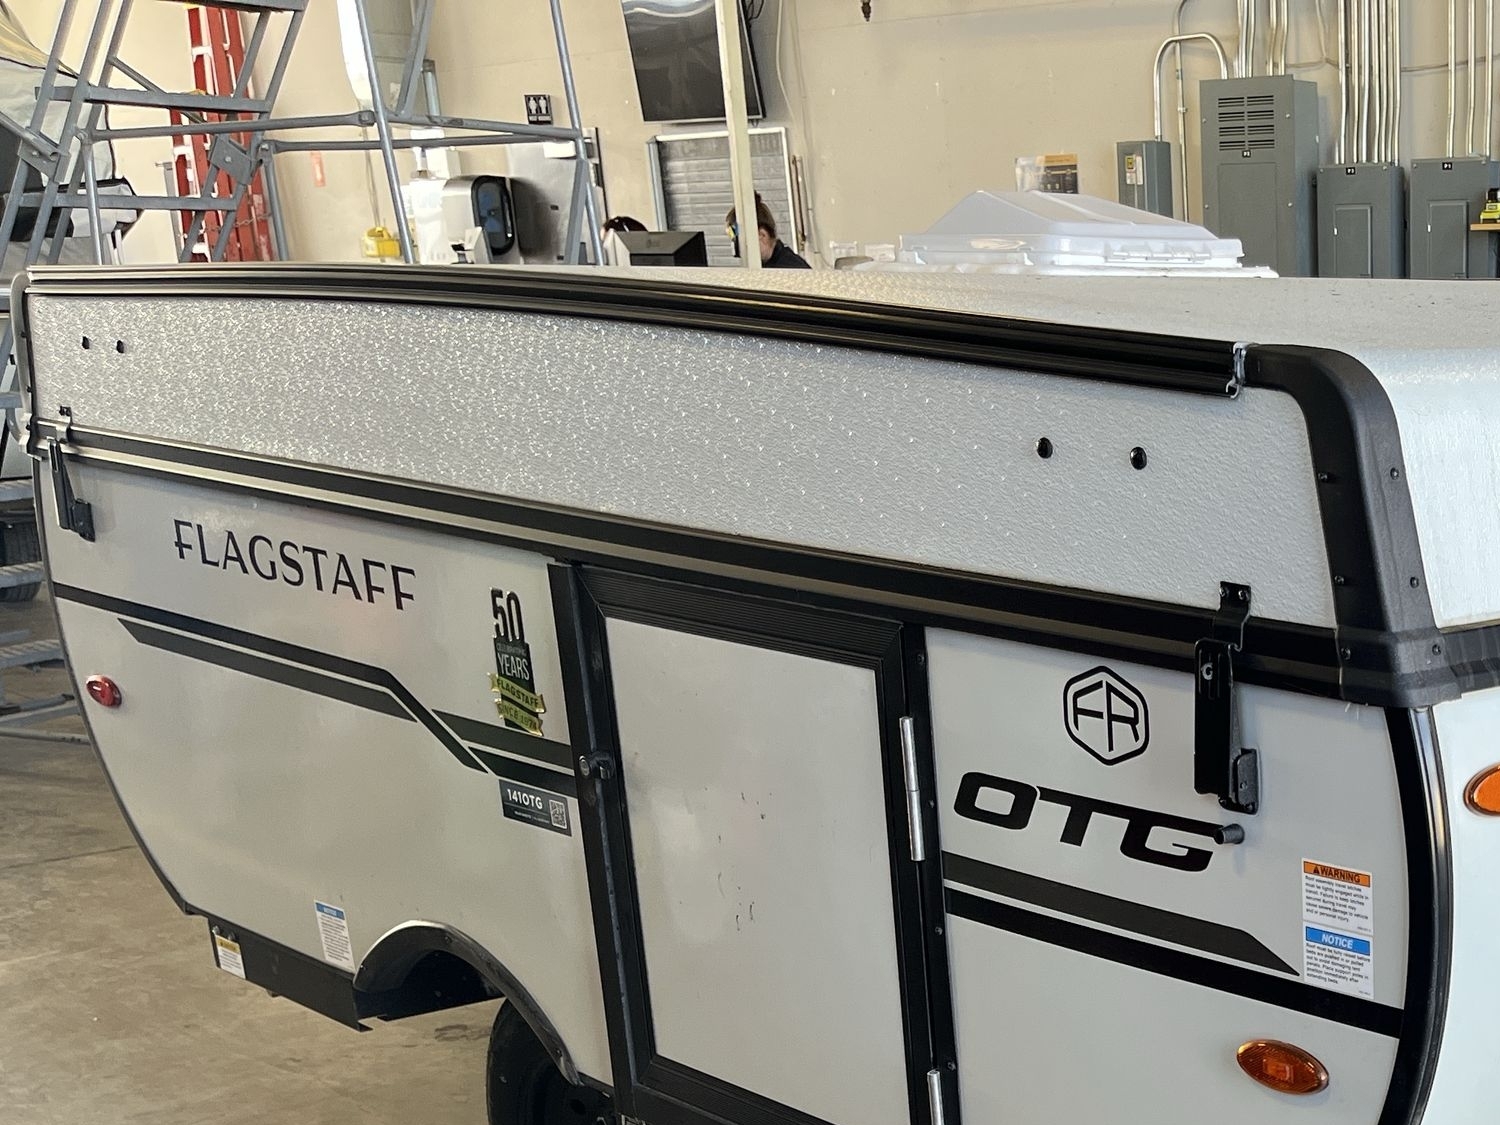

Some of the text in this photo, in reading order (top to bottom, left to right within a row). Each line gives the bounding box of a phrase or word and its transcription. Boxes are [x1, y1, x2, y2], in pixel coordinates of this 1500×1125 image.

[174, 518, 417, 610] FLAGSTAFF
[490, 588, 525, 641] 50
[497, 652, 530, 681] YEARS
[496, 678, 540, 708] FLAGSTAFF
[507, 788, 543, 810] 141OTG
[953, 771, 1224, 873] OTG
[1320, 866, 1361, 883] WARNING
[1321, 933, 1354, 949] NOTICE
